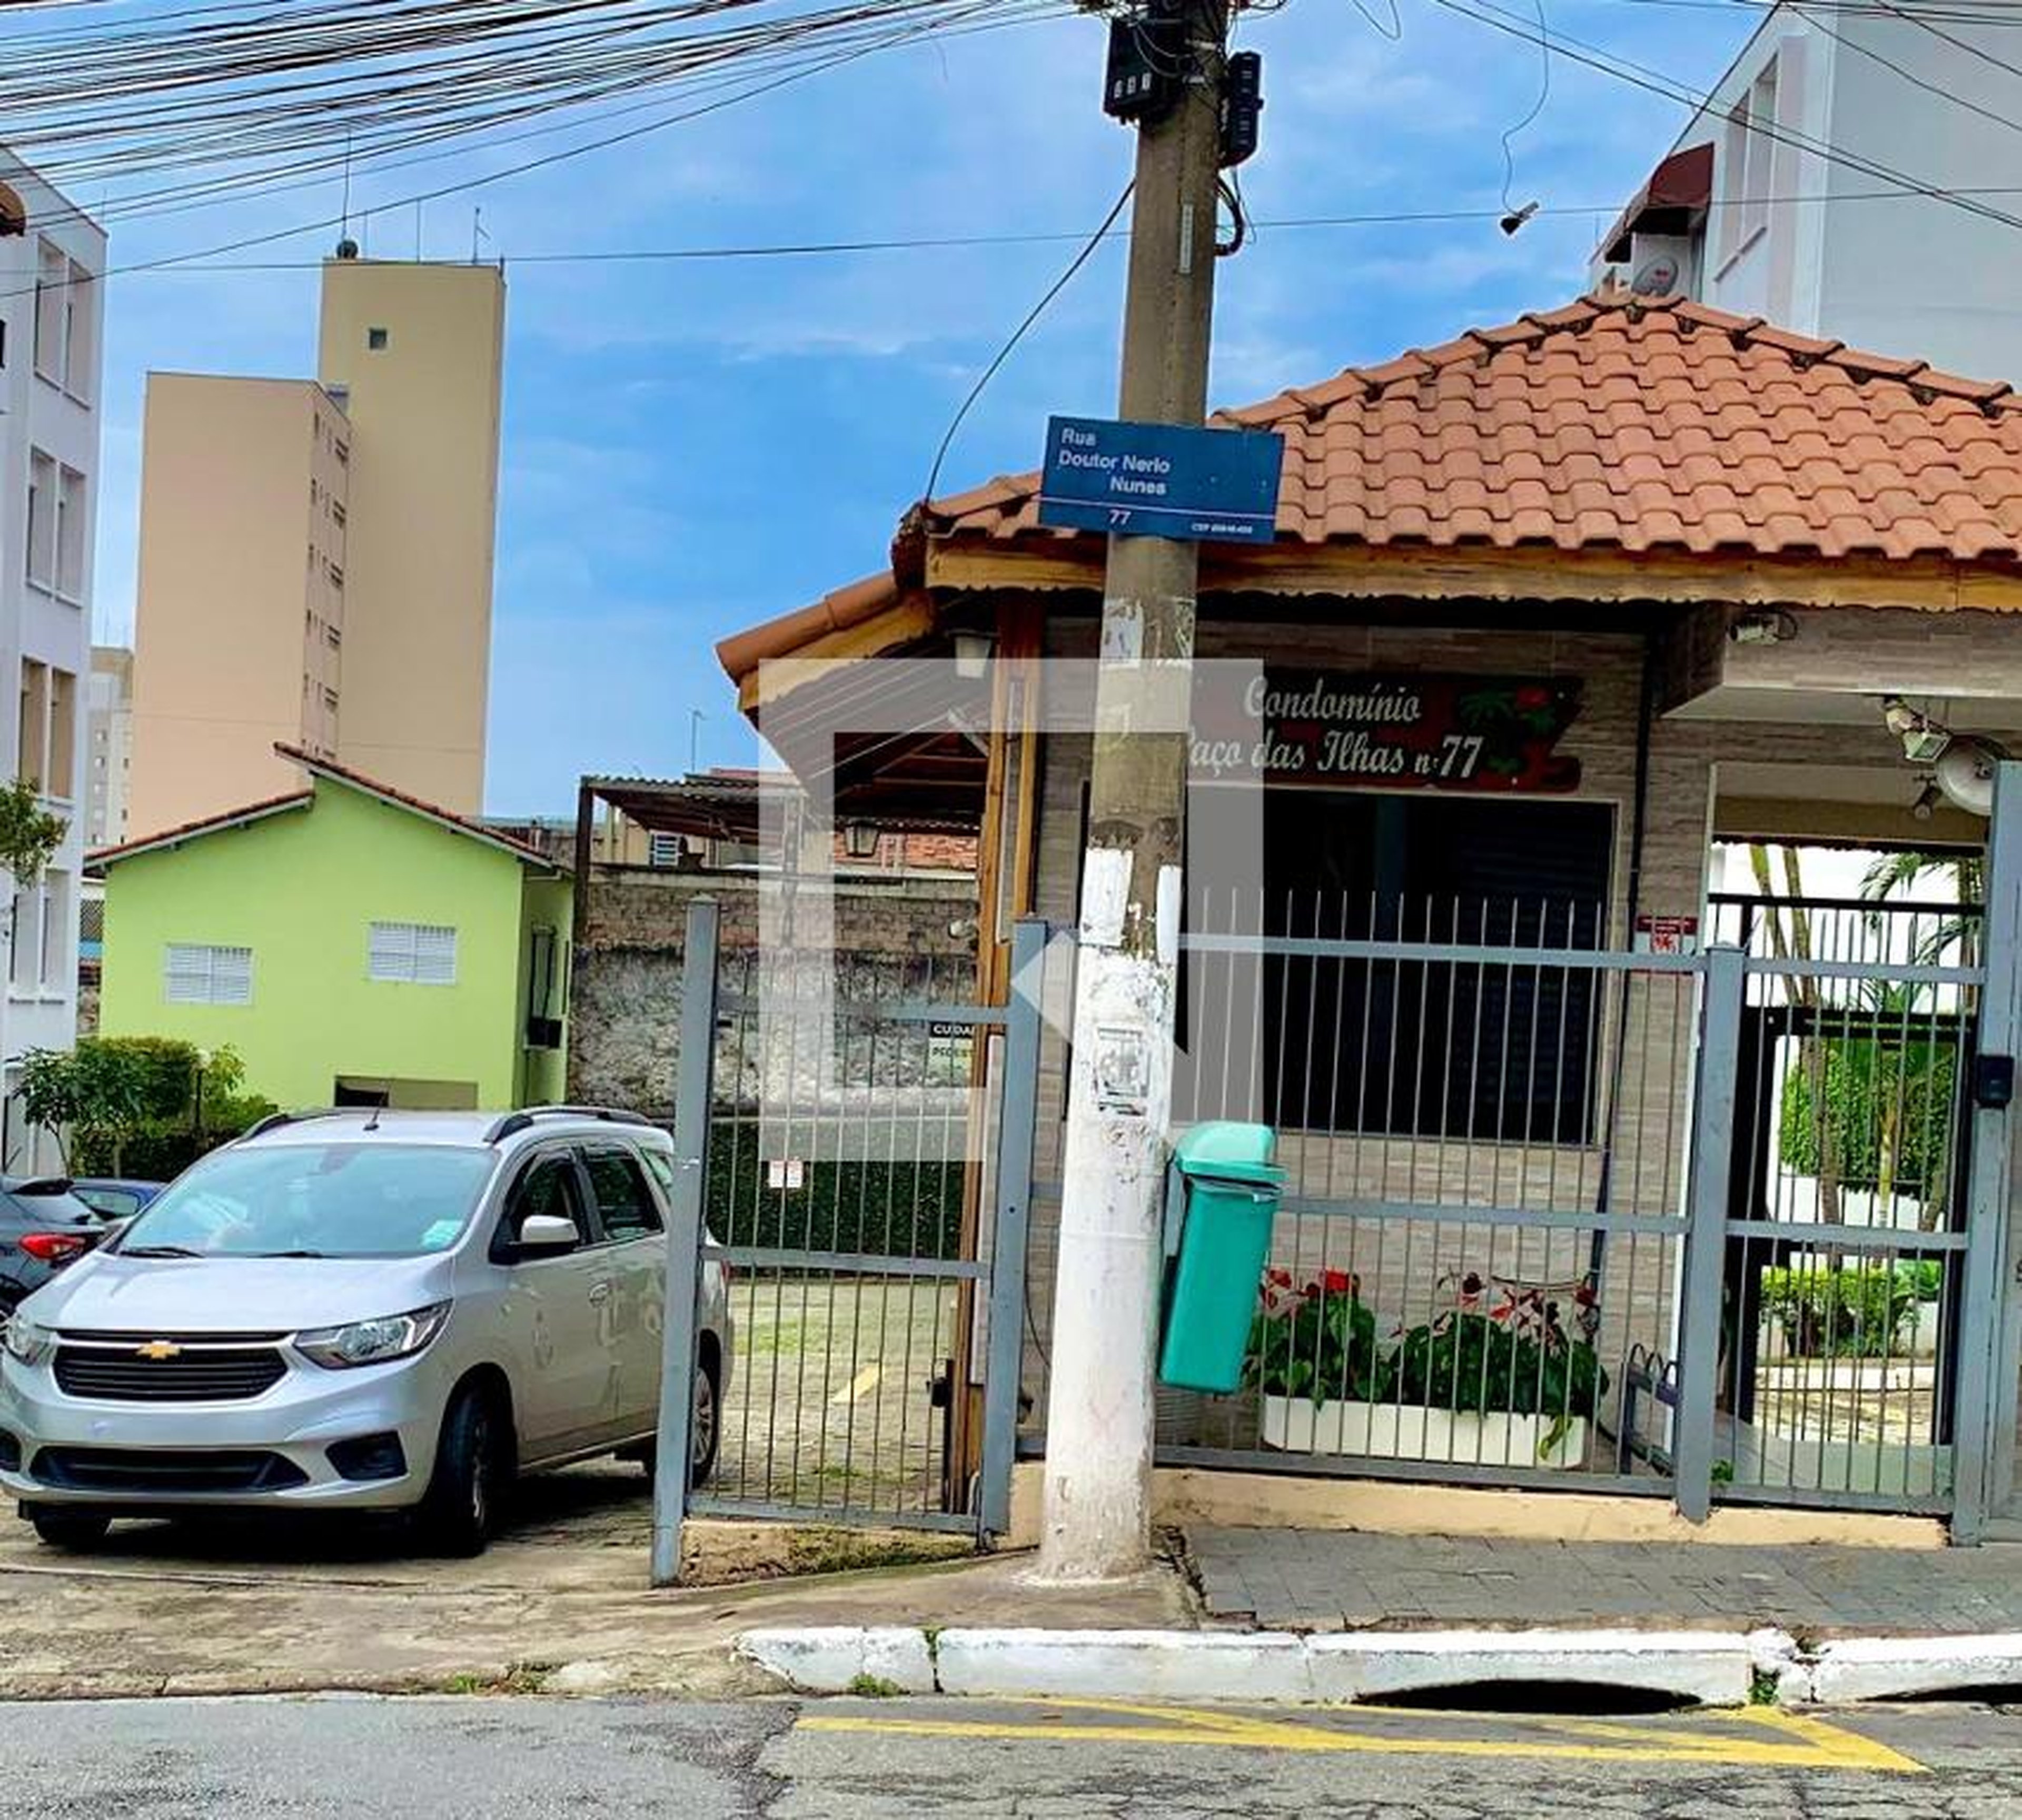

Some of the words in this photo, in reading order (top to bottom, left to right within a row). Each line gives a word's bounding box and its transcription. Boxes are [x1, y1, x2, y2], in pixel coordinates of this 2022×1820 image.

[1061, 427, 1096, 446] Rua
[1058, 449, 1118, 469] Doutor
[1110, 475, 1166, 495] Nunes
[1109, 509, 1131, 525] 77
[1245, 675, 1421, 722] Condomínio
[1251, 728, 1305, 769] das
